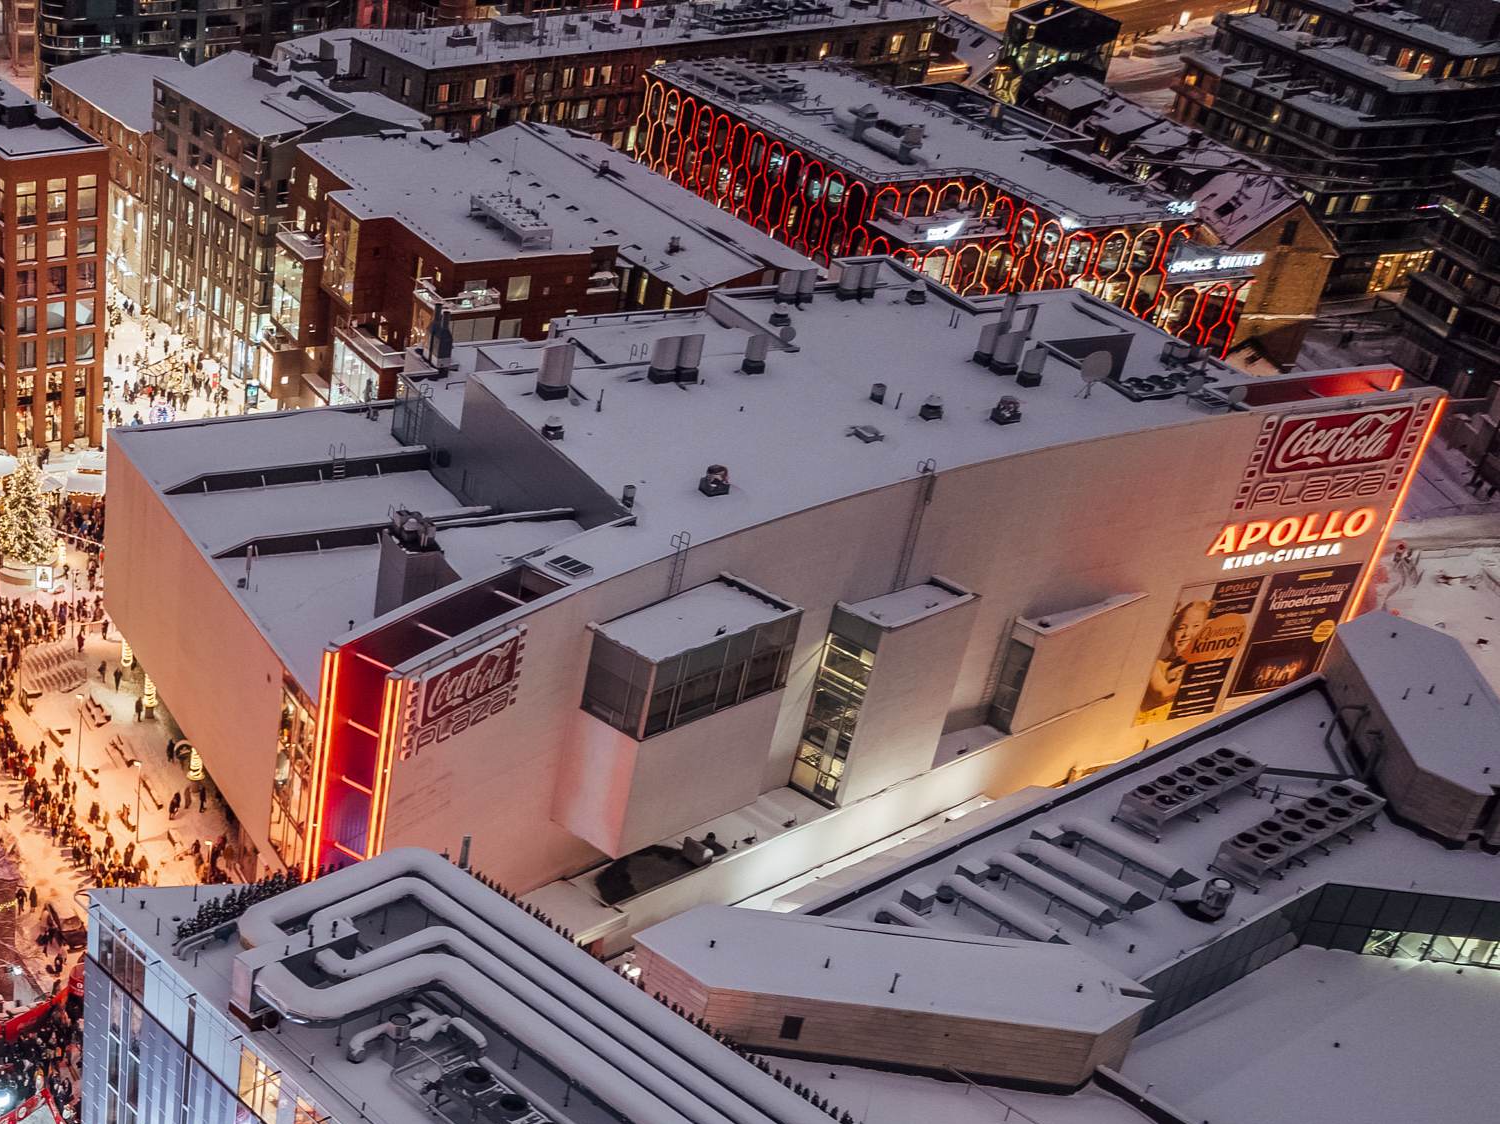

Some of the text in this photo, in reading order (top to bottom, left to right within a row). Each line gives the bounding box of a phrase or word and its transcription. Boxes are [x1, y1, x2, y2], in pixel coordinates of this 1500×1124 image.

[1275, 411, 1409, 468] Coca-Cola
[1207, 507, 1377, 556] APOLLO
[1219, 581, 1259, 593] APOLLO
[1191, 632, 1243, 654] kinno!
[426, 639, 516, 718] Coca-Cola
